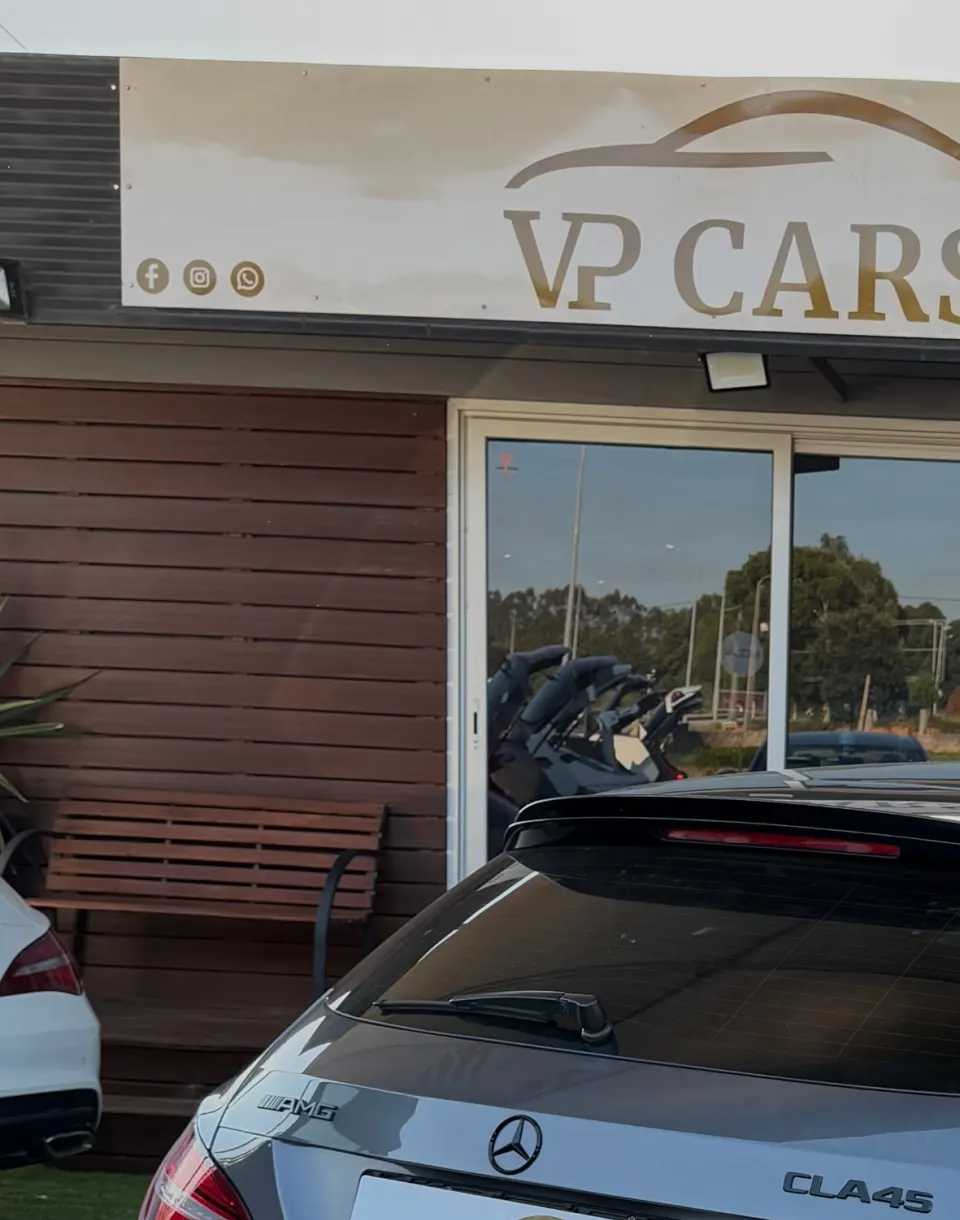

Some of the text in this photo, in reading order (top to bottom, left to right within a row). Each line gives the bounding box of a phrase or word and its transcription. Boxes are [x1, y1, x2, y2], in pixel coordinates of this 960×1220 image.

[503, 210, 642, 311] VP
[276, 1096, 339, 1121] AMG
[782, 1171, 934, 1214] CLA45
